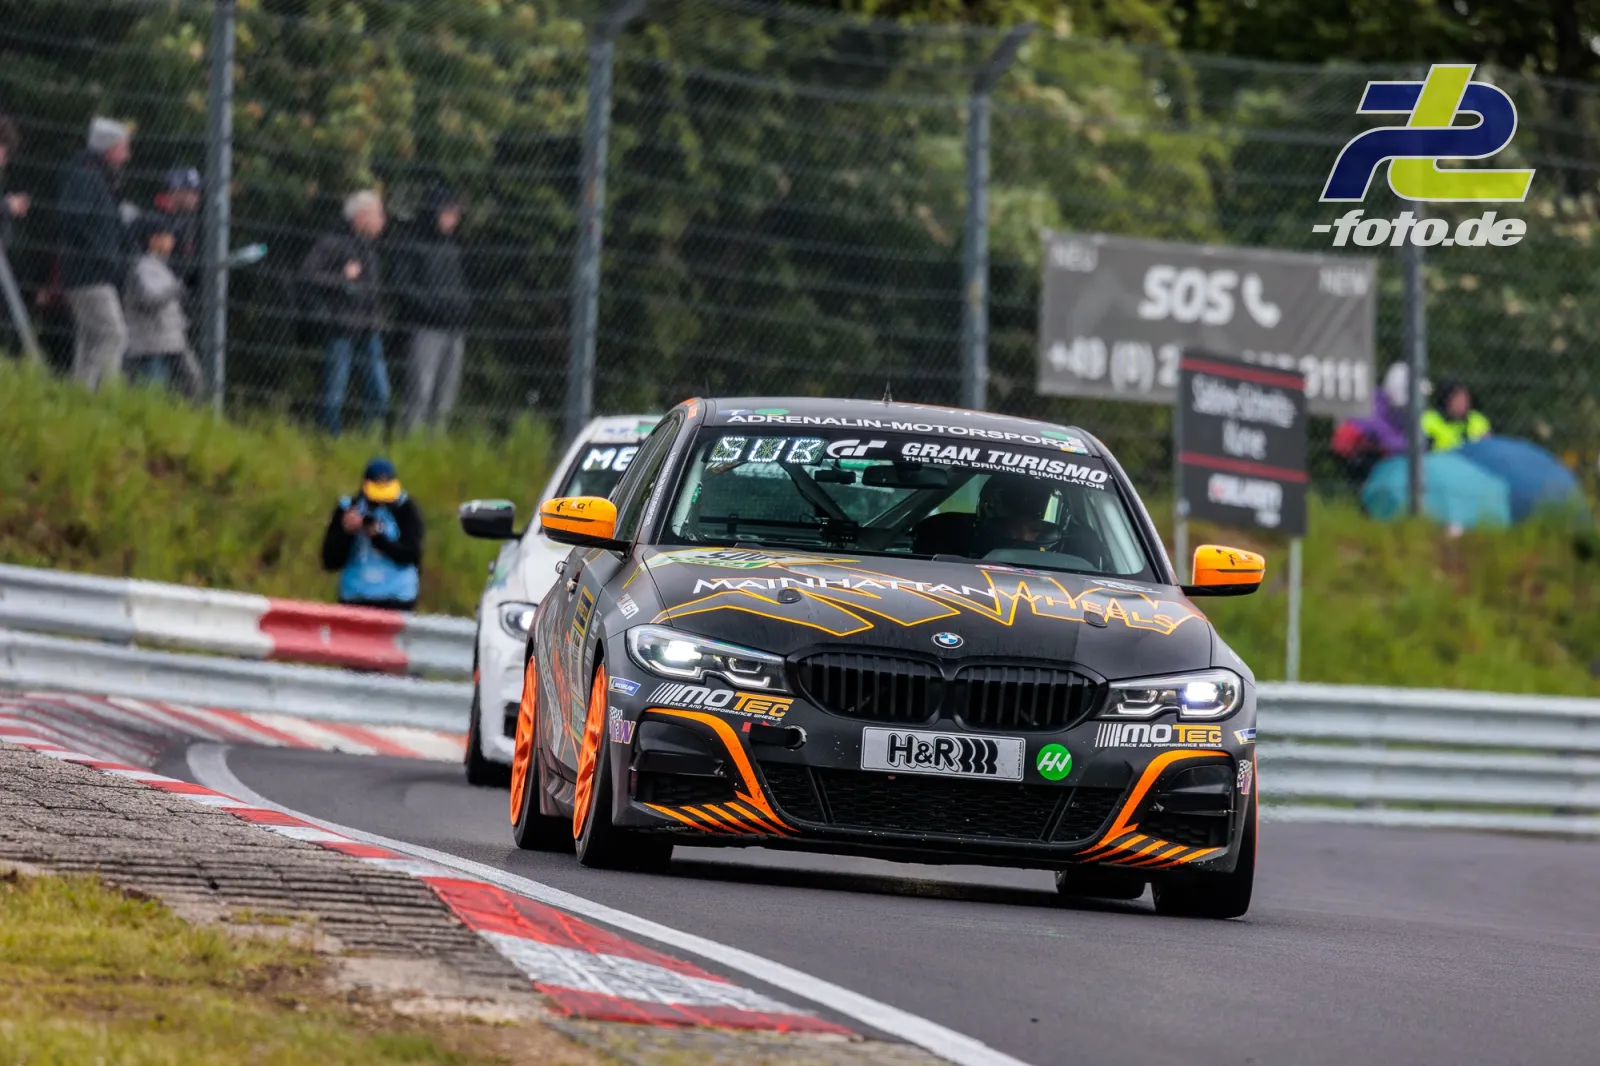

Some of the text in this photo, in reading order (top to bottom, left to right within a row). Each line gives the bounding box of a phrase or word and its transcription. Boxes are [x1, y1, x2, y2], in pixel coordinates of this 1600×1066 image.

[1138, 264, 1239, 326] SOS
[1318, 266, 1369, 296] NEW
[901, 442, 1109, 484] GRAN TURISMO
[933, 458, 969, 467] REAL
[971, 461, 1026, 474] DRIVING
[1028, 470, 1105, 490] SIMULATOR
[692, 576, 997, 599] MAINHATTAN
[703, 705, 752, 718] PERFORMANCE
[753, 713, 783, 722] WHEELS
[887, 733, 960, 771] H&R
